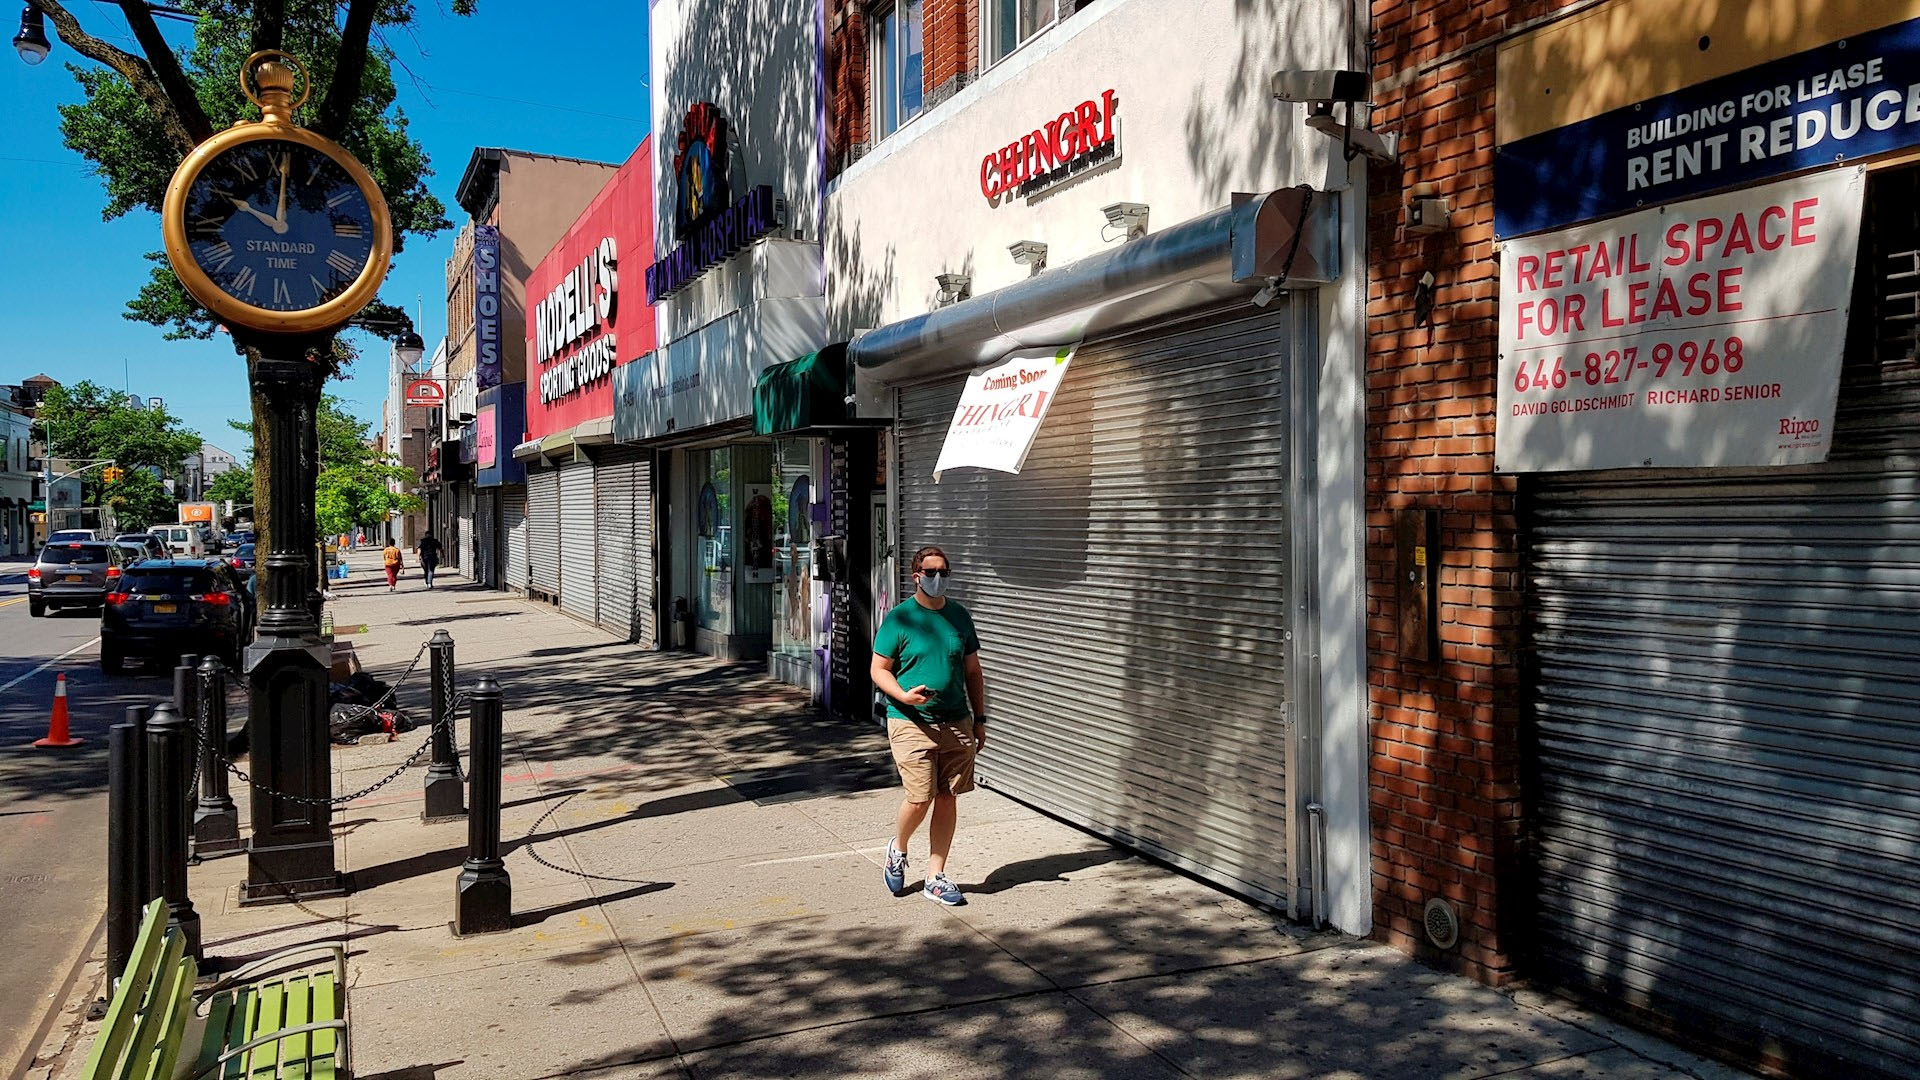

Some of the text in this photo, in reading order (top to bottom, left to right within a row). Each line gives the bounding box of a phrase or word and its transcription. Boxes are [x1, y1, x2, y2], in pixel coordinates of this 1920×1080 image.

[1627, 57, 1883, 149] BUILDING FOR LEASE
[981, 89, 1115, 199] CHINGRI
[1627, 133, 1728, 191] RENT
[246, 240, 315, 255] STANDARD
[700, 186, 766, 269] HOSPITAL
[1517, 197, 1819, 293] RETAIL SPACE
[266, 257, 297, 269] TIME
[479, 248, 498, 365] SHOES
[536, 237, 613, 364] MODELL'S
[1517, 267, 1743, 340] FOR LEASE
[540, 333, 611, 405] SPORTING GOODS
[983, 373, 1017, 391] Coming
[1514, 336, 1744, 393] 646-827-9968
[1648, 383, 1781, 405] RICHARD SENIOR
[1512, 393, 1635, 417] DAVID GOLDSCHMIDT
[1779, 416, 1819, 439] Ripco
